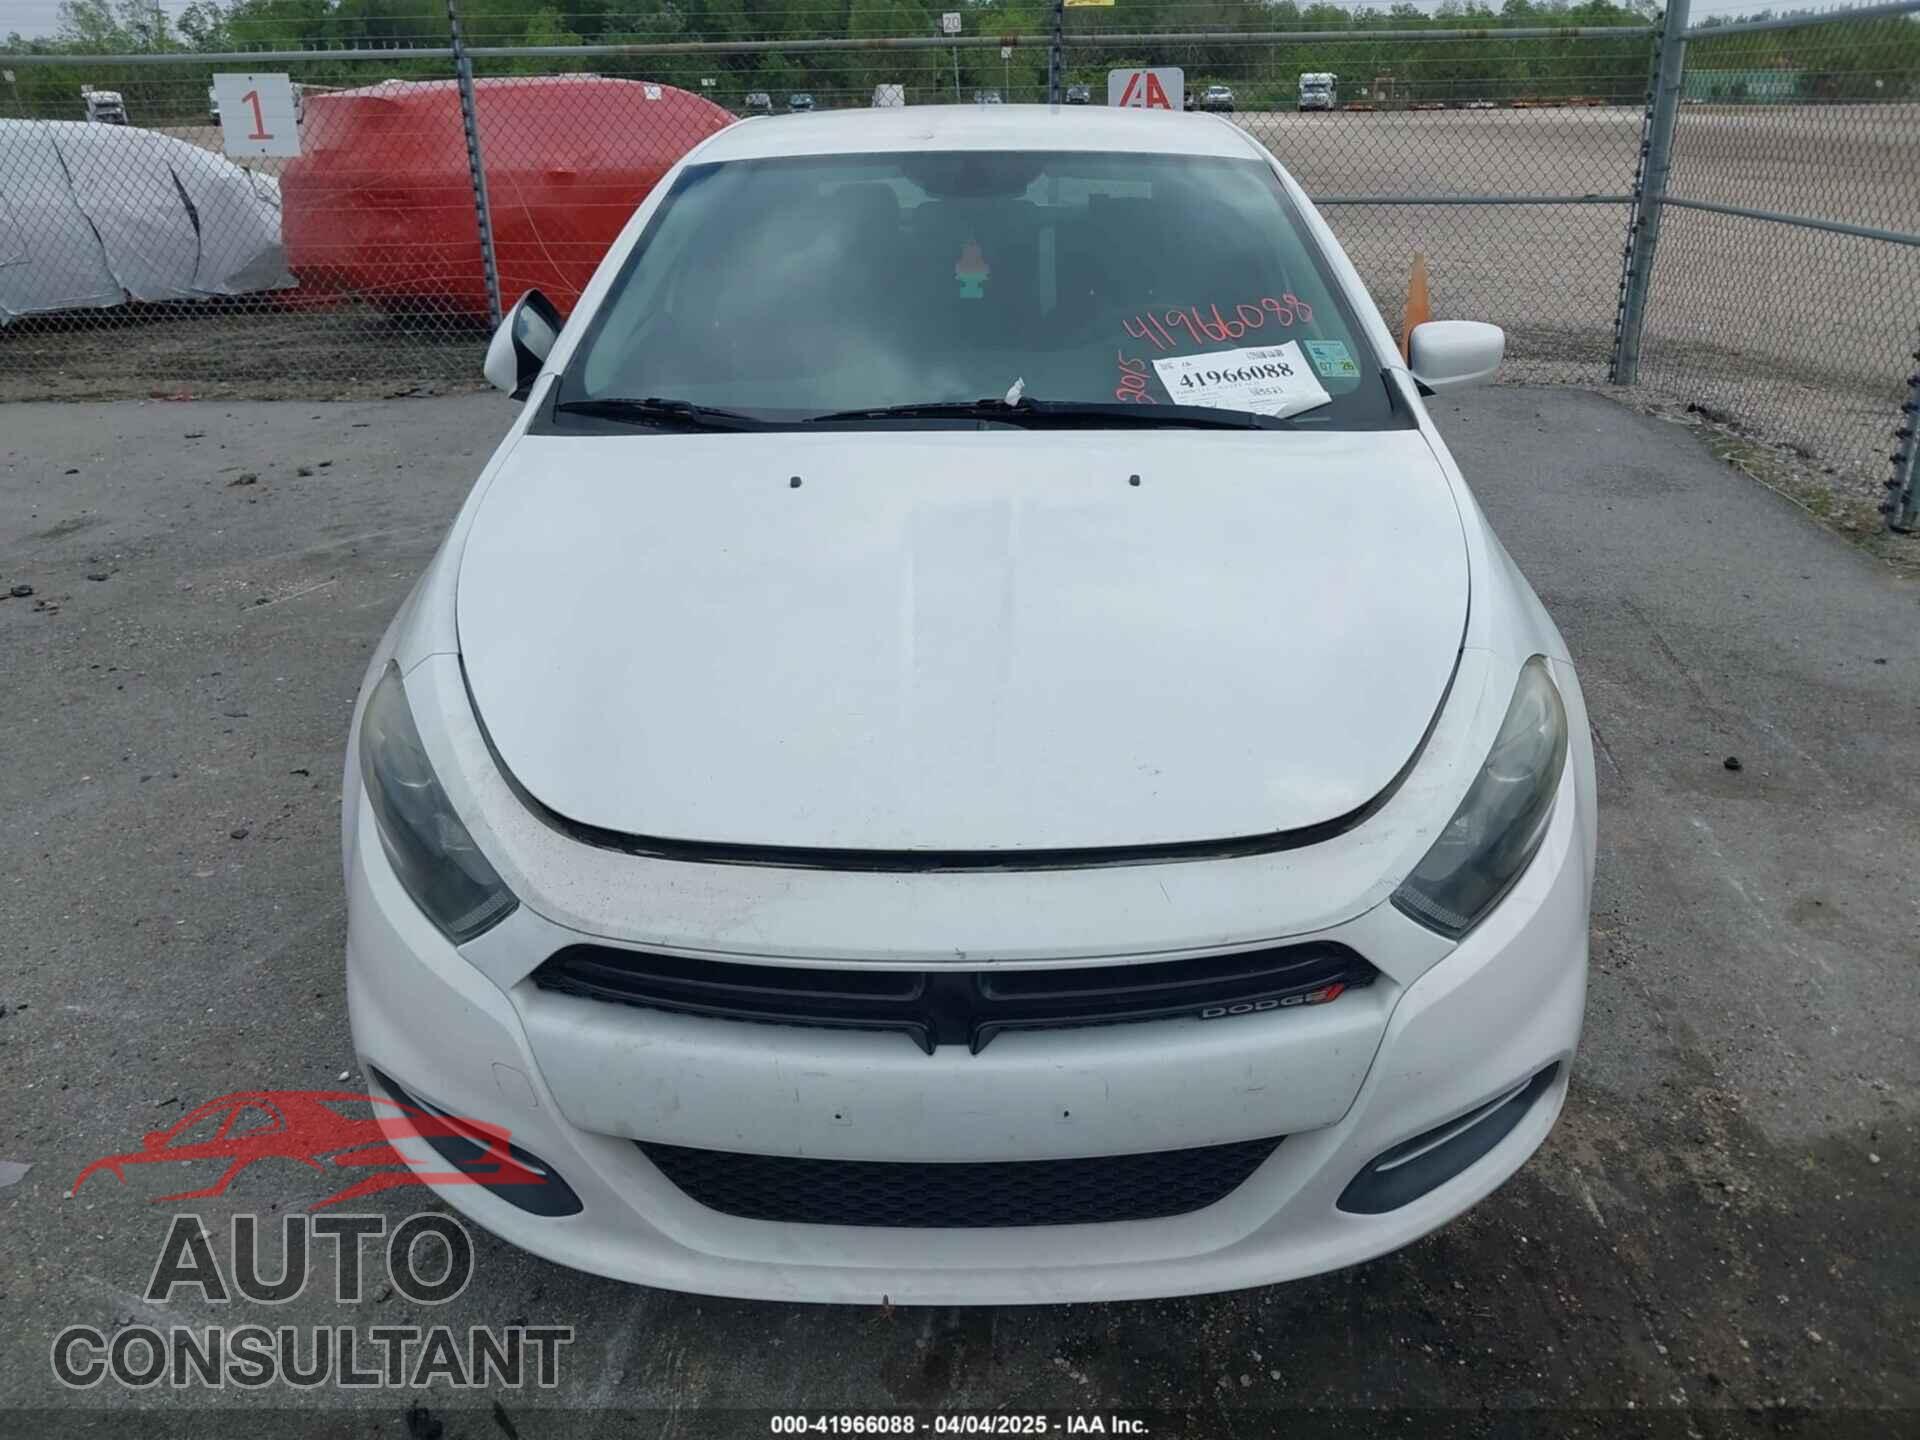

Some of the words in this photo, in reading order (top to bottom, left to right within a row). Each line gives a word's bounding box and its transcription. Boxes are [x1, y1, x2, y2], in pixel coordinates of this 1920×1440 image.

[241, 90, 274, 140] 1
[1122, 292, 1313, 350] 41966088
[1179, 361, 1295, 389] 41966088
[1201, 990, 1330, 1019] DODGE
